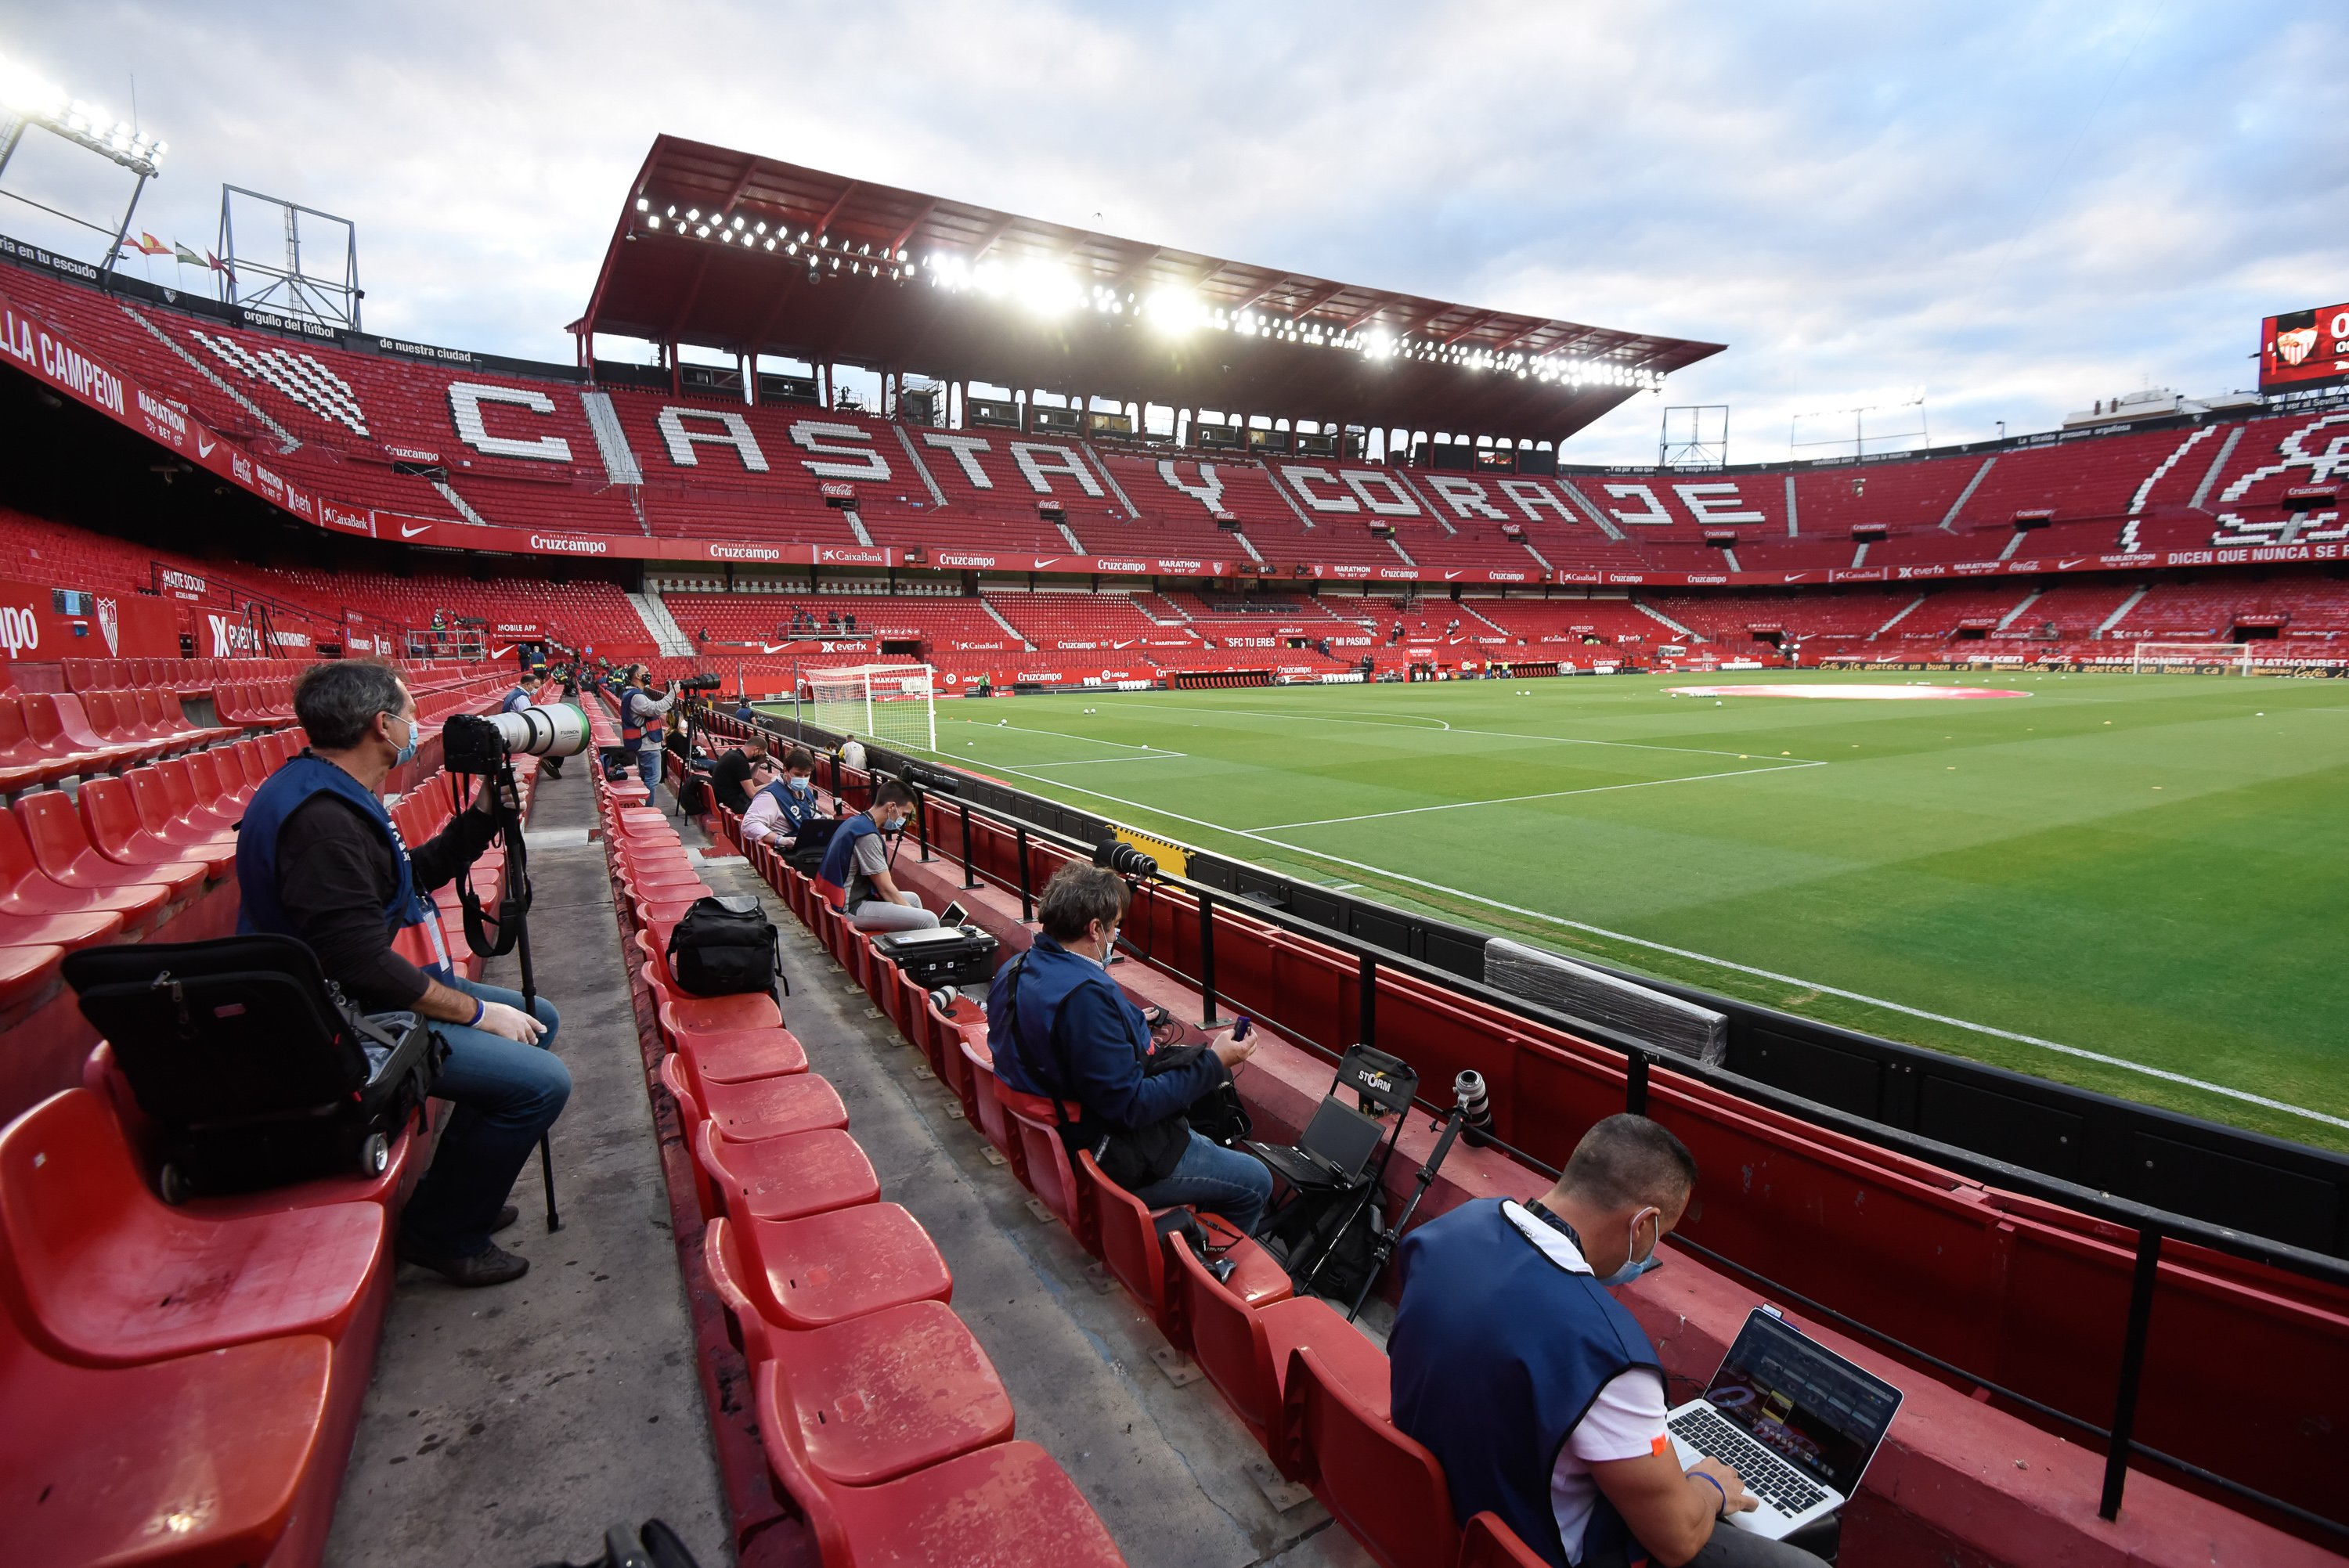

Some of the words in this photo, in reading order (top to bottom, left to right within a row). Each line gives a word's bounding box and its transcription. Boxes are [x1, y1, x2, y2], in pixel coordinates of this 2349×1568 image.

[19, 245, 34, 260] en
[38, 249, 50, 265] tu
[53, 257, 97, 279] escudo
[244, 310, 281, 328] orgullo
[284, 319, 301, 332] del
[303, 322, 334, 339] fútbol
[380, 337, 393, 349] de
[395, 341, 435, 357] nuestra
[437, 348, 471, 362] ciudad
[41, 332, 124, 415] CAMPEON
[2272, 403, 2284, 412] de
[2302, 399, 2311, 408] al
[2312, 393, 2344, 407] Sevilla
[138, 389, 186, 434] MARATHON
[158, 425, 171, 441] BET
[256, 463, 283, 492] MARATHON
[332, 509, 368, 530] CaixaBank
[530, 534, 607, 554] Cruzcampo
[710, 543, 780, 561] Cruzcampo
[836, 550, 883, 562] CaixaBank
[2168, 550, 2213, 565] DICEN
[2217, 549, 2247, 562] QUE
[2252, 546, 2310, 561] NUNCA
[2315, 544, 2337, 558] SE
[940, 553, 995, 568] Cruzcampo
[1098, 558, 1146, 573] Cruzcampo
[1159, 560, 1201, 568] MARATHON
[1954, 561, 2000, 571] MARATHON
[1381, 568, 1419, 579] Cruzcampo
[1489, 571, 1525, 581] Cruzcampo
[1914, 564, 1945, 576] everfx
[1571, 573, 1597, 582] CaixaBank
[1610, 573, 1644, 582] Cruzcampo
[1687, 574, 1727, 584] Cruzcampo
[836, 641, 868, 651] everfx
[1058, 640, 1097, 650] Cruzcampo
[1229, 637, 1243, 647] SFC
[1245, 637, 1255, 647] TU
[1257, 637, 1276, 647] ERES
[1336, 637, 1344, 646] MI
[1346, 636, 1371, 646] PASION
[1479, 636, 1506, 644] Cruzcampo
[1865, 663, 1905, 672] apetece
[1925, 662, 1950, 671] buen
[2232, 657, 2348, 668] MARATHONBET
[1277, 665, 1312, 674] Cruzcampo
[2082, 664, 2134, 673] apetece
[2163, 665, 2196, 674] buen
[2293, 665, 2329, 678] Cafés
[1017, 672, 1063, 682] Cruzcampo
[1358, 1069, 1391, 1093] STORM
